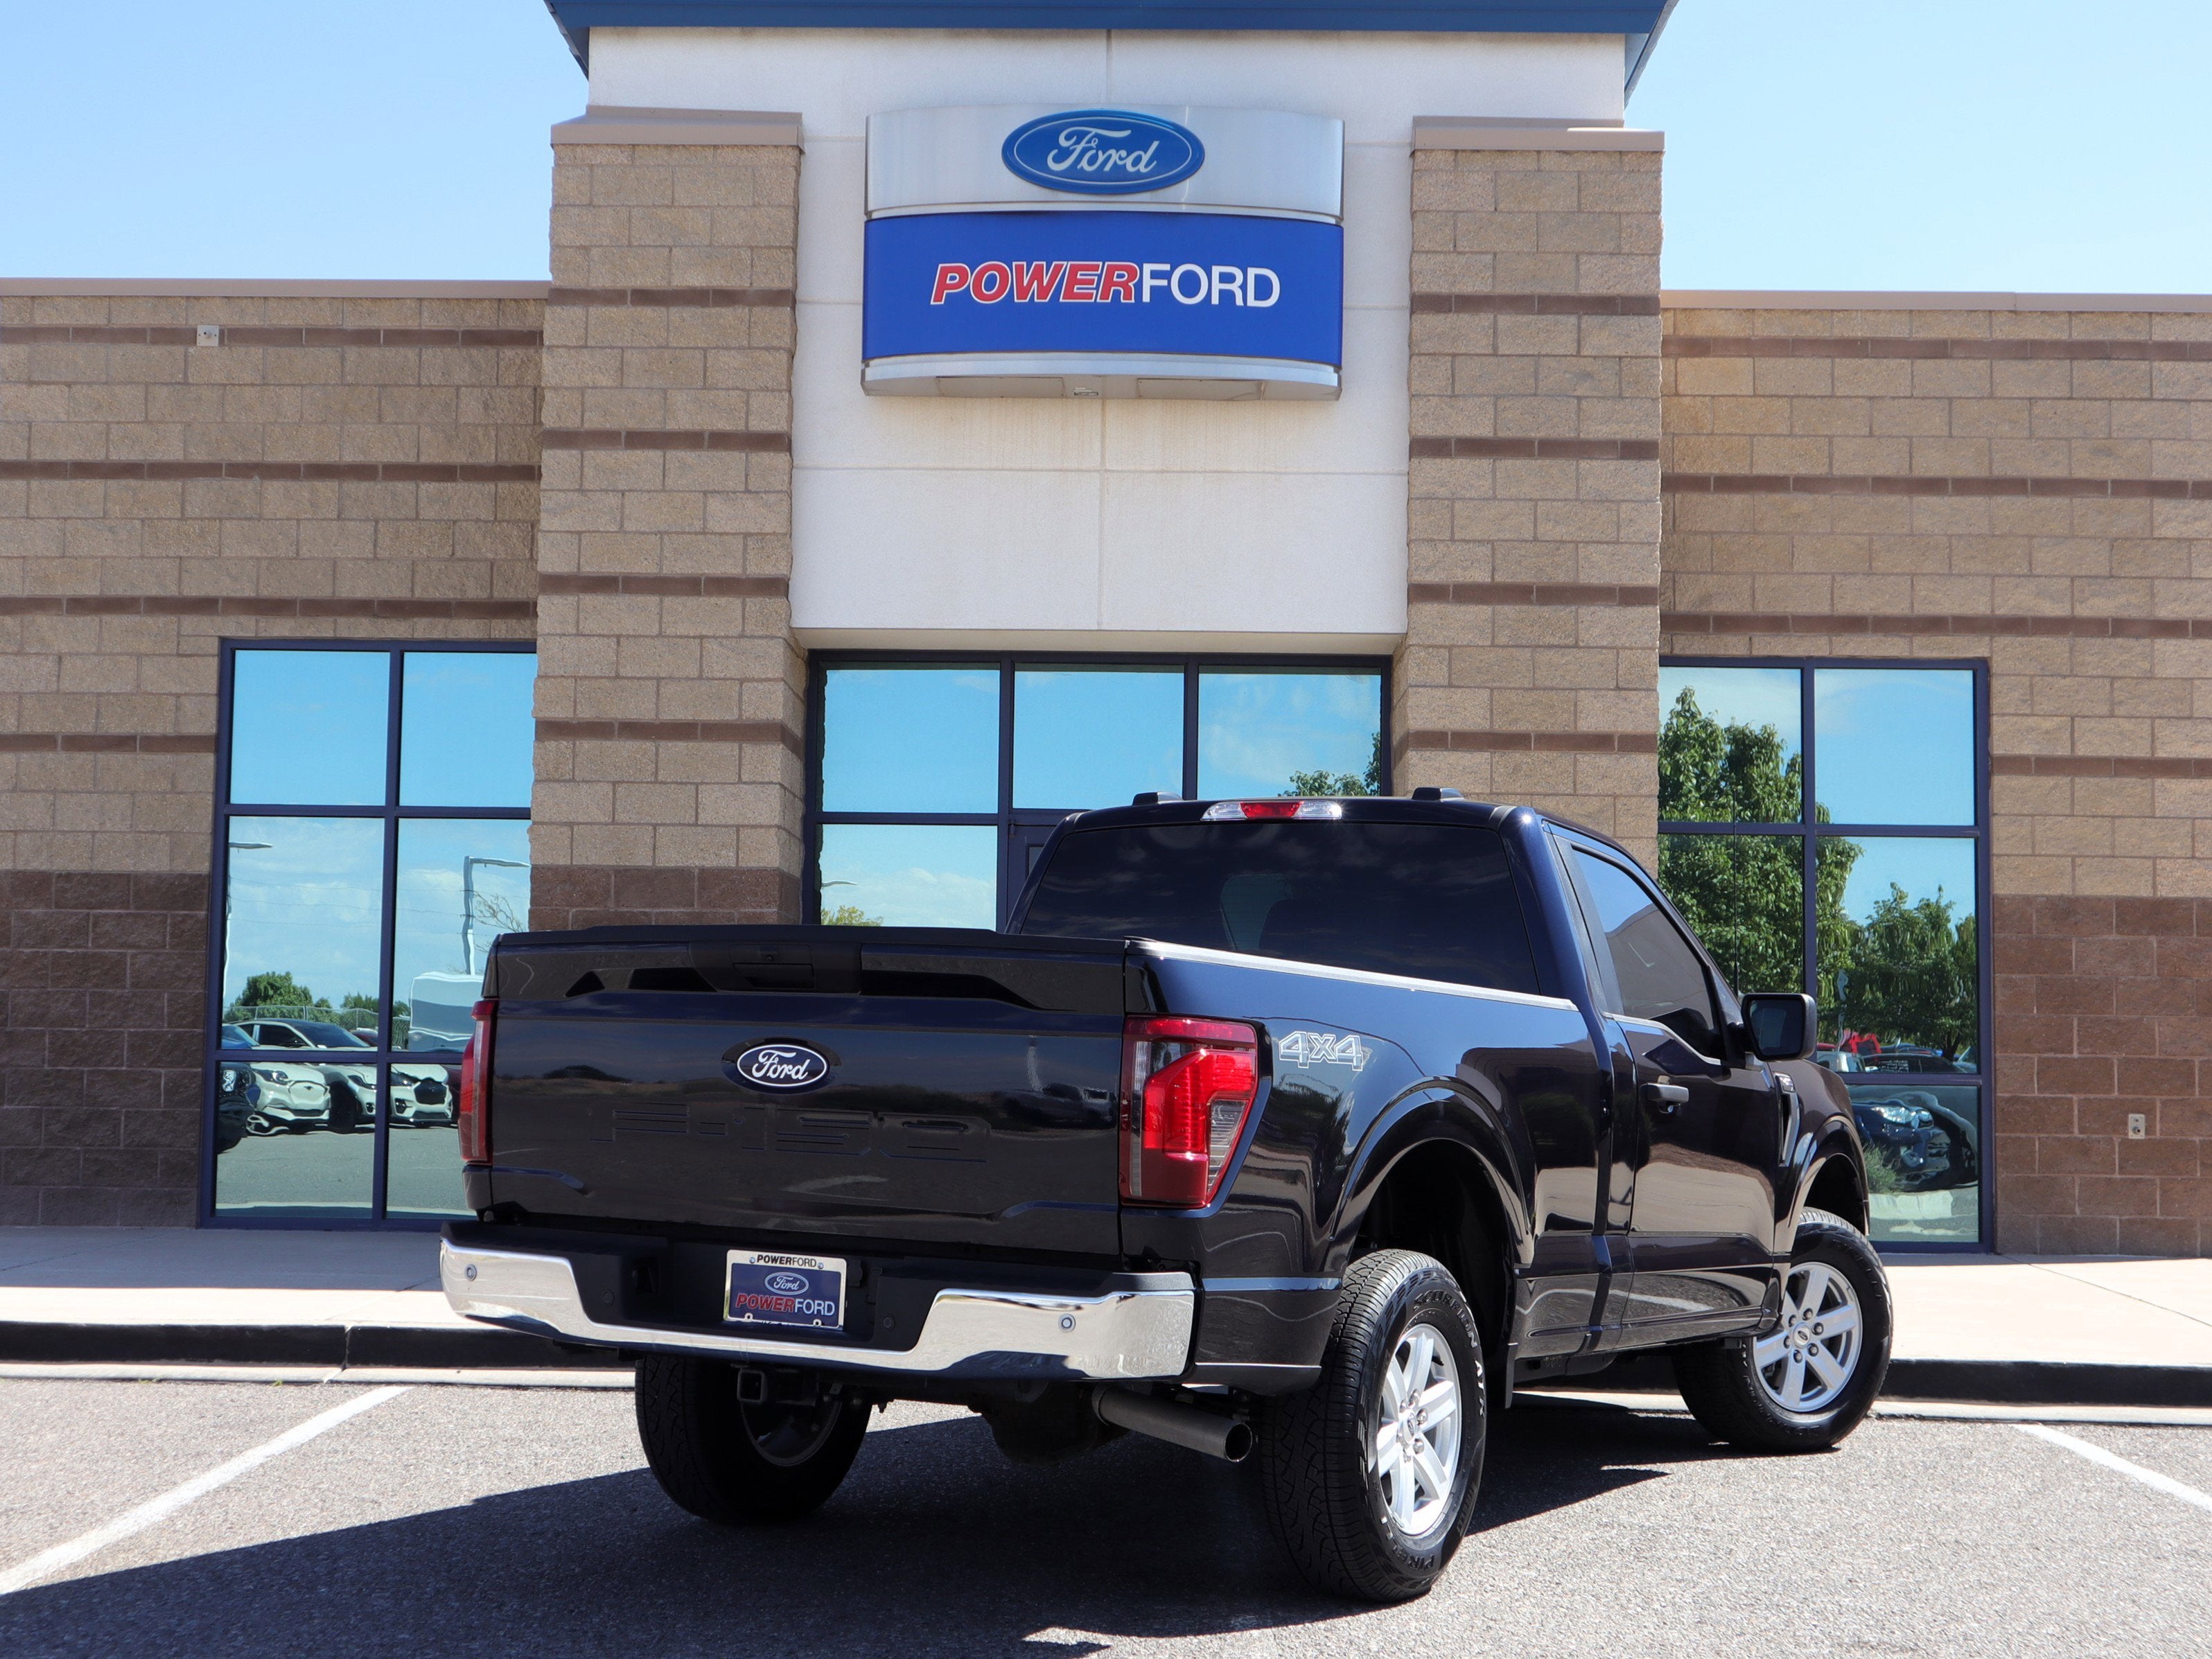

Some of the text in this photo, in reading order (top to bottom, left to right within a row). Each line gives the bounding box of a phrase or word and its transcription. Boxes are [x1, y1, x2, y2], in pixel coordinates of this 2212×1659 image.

[1047, 126, 1159, 174] Ford
[930, 261, 1280, 307] POWERFORD
[751, 1049, 810, 1080] Ford
[756, 1254, 816, 1267] POWERFORD
[773, 1276, 800, 1290] Ford
[735, 1293, 835, 1316] POWERFORD
[1414, 1290, 1477, 1348] SCORPION
